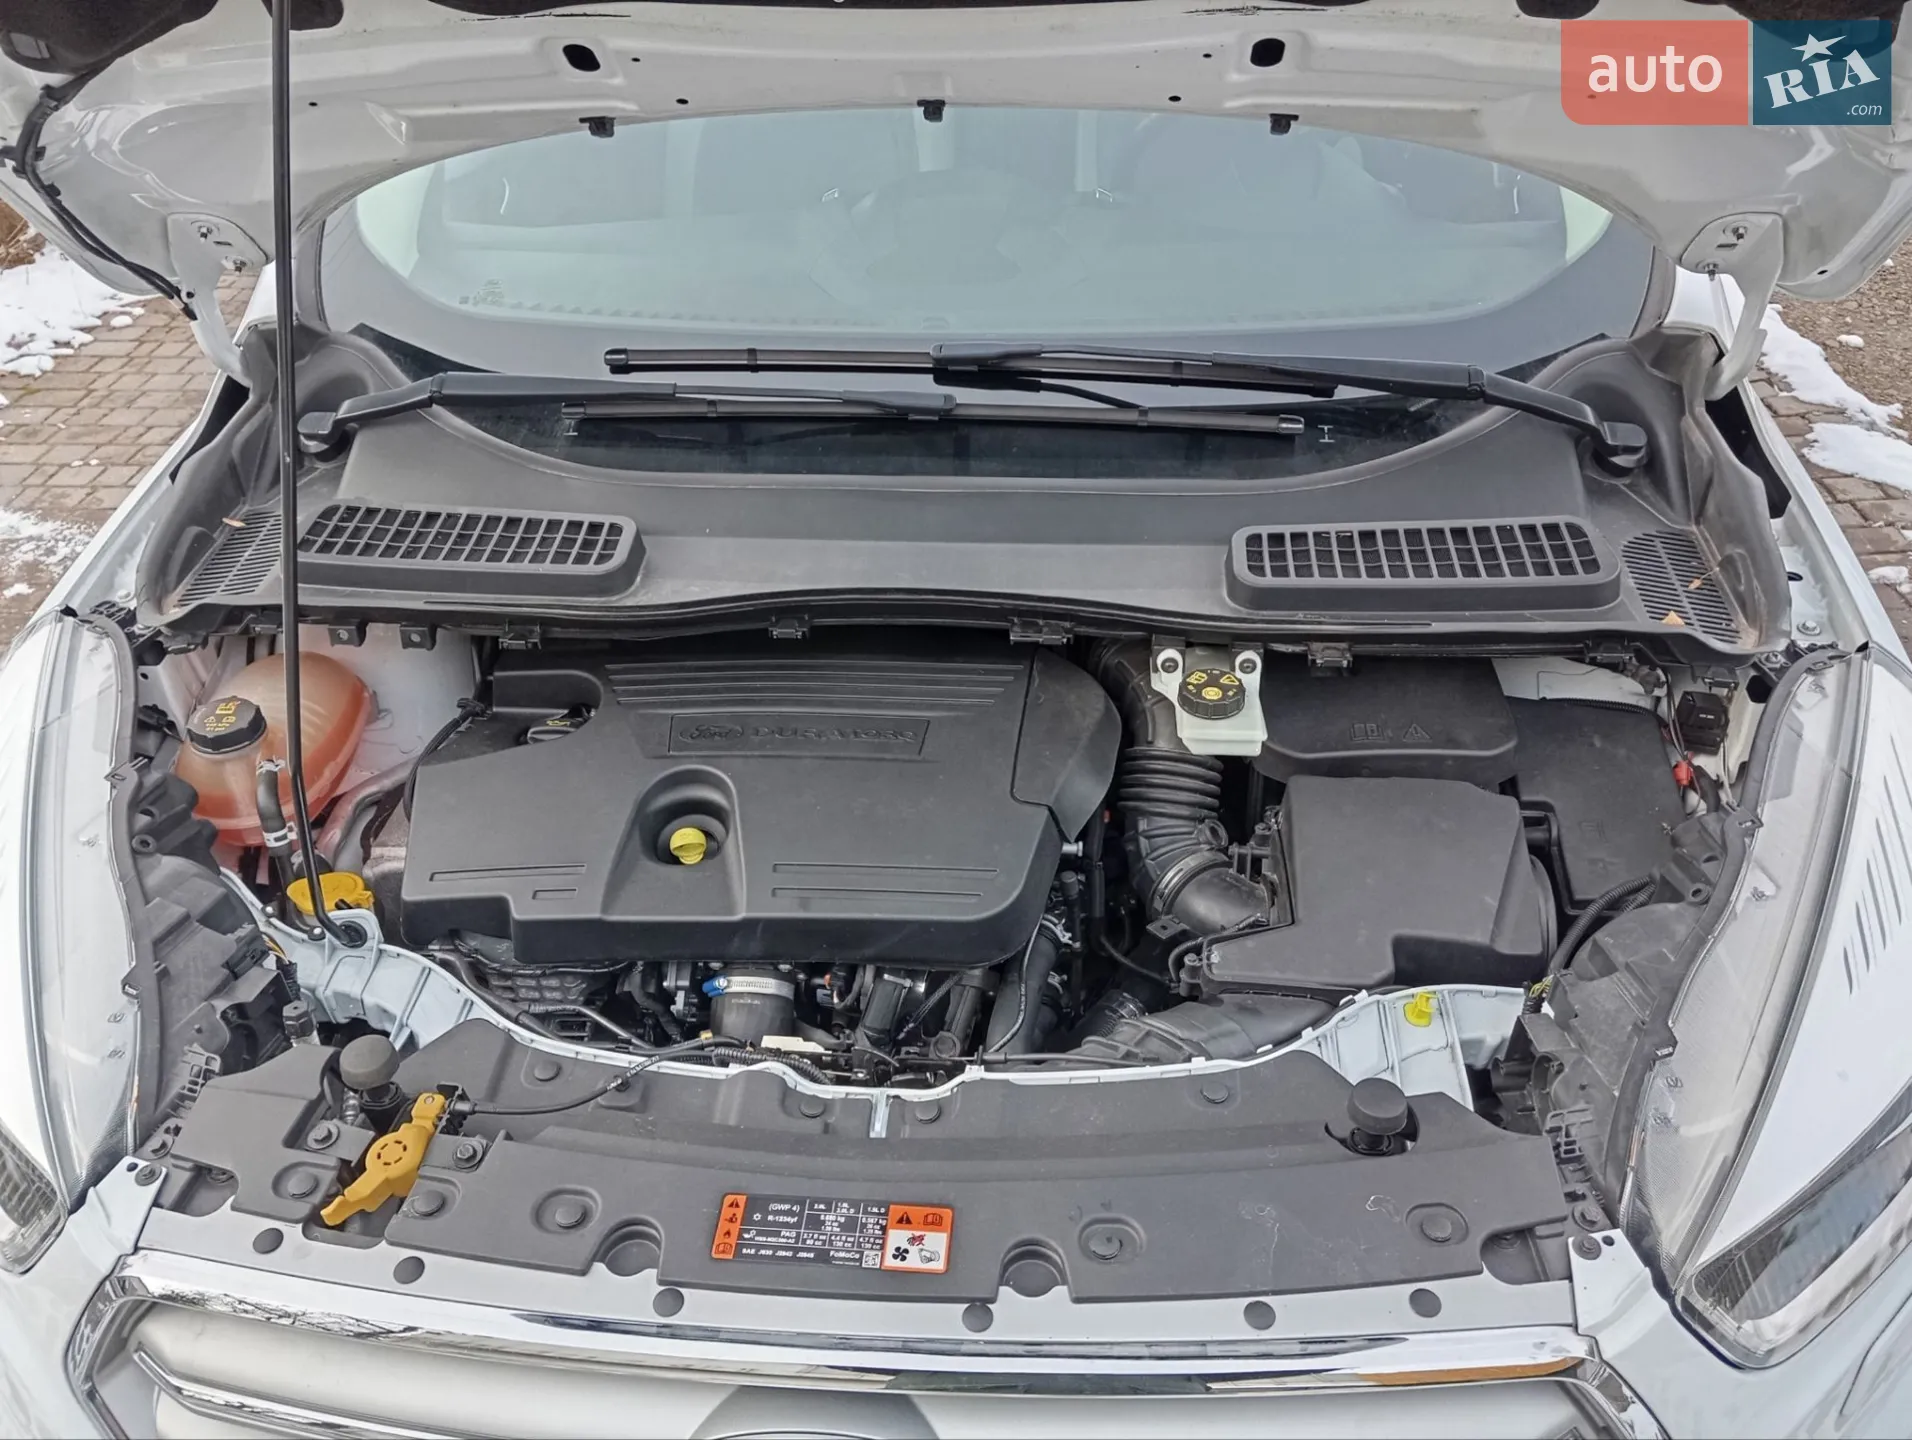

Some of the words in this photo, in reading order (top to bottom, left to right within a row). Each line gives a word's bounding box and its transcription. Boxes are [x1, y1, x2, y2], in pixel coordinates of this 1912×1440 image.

[768, 1203, 791, 1212] (GWP
[791, 1204, 800, 1213] 4)
[767, 1214, 798, 1224] R-1234yf
[830, 1250, 860, 1259] FoMoCo
